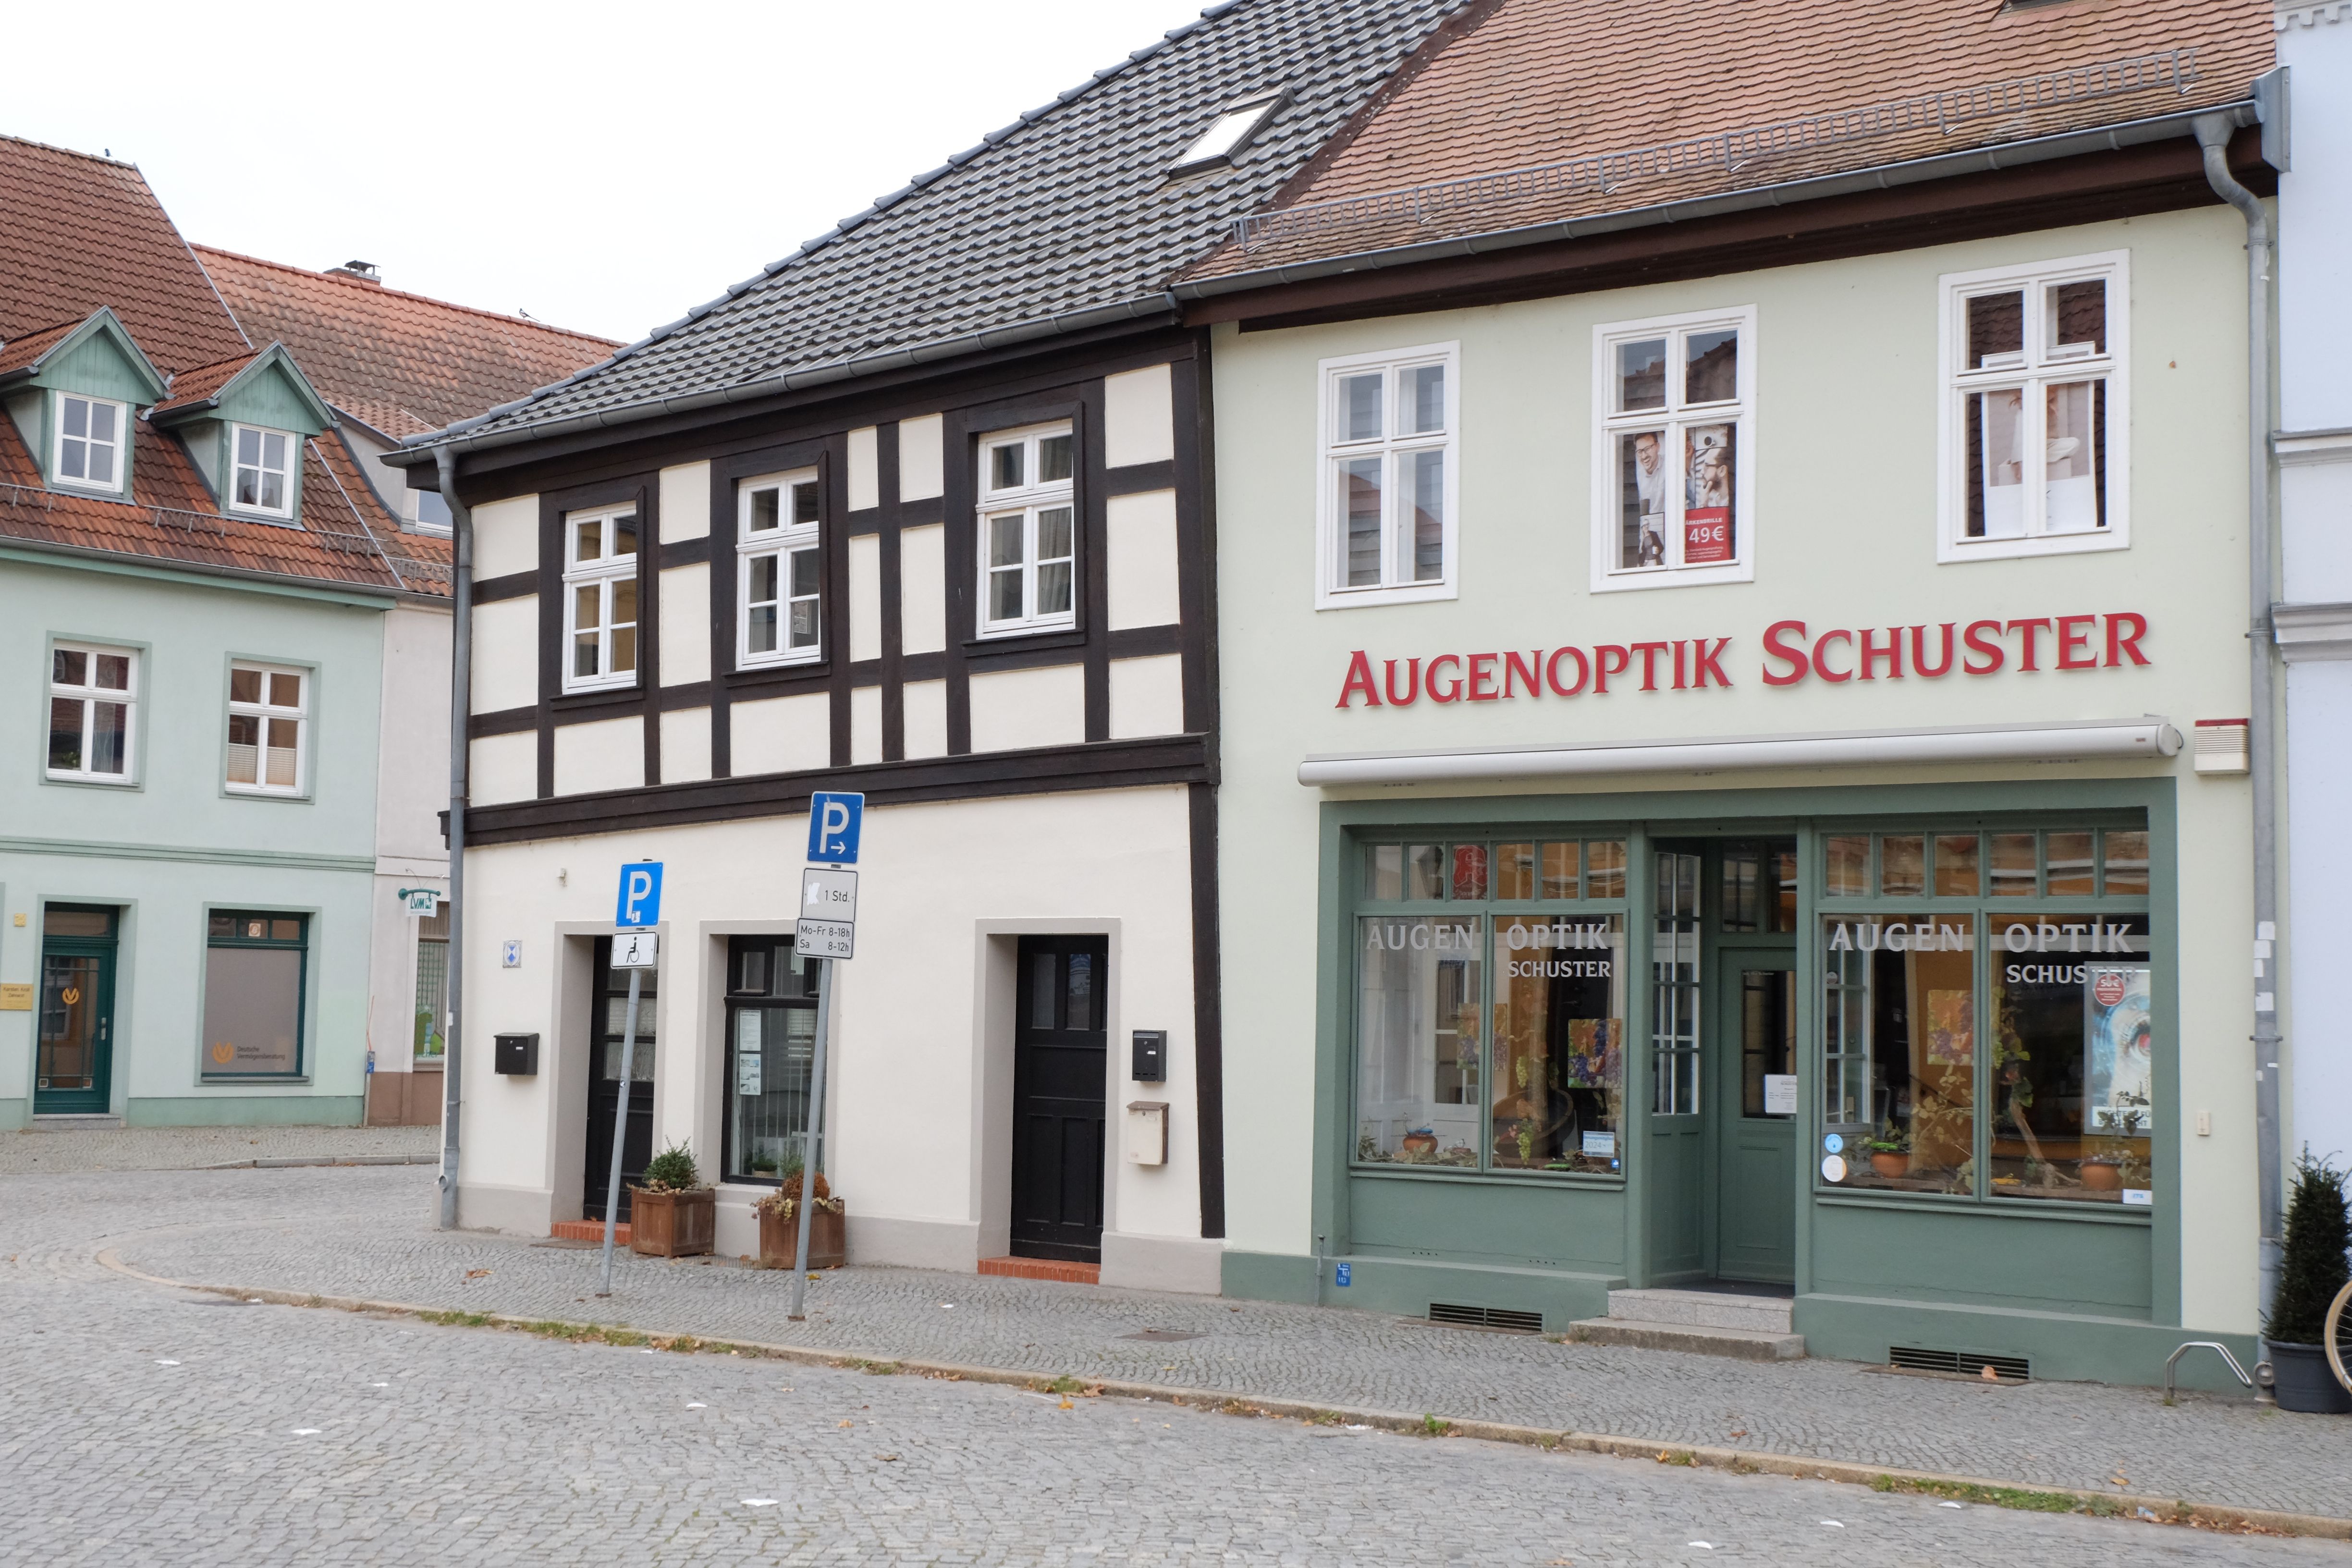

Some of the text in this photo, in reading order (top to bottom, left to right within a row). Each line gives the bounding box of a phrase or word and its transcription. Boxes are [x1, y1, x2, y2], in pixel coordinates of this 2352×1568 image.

[1689, 526, 1724, 543] 49€
[1335, 612, 2152, 709] AUGENOPTIK SCHUSTER
[819, 802, 850, 854] P
[410, 898, 424, 909] LVM
[626, 870, 652, 919] P
[825, 890, 850, 902] 1 Std.
[800, 925, 850, 937] Mo-Fr 8-18h
[1366, 923, 1608, 951] AUGEN OPTIK
[1829, 923, 2134, 953] AUGEN OPTIK
[799, 939, 849, 952] Sa 8-12h
[1508, 960, 1611, 978] SCHUSTER
[2007, 965, 2137, 984] SCHUSTER
